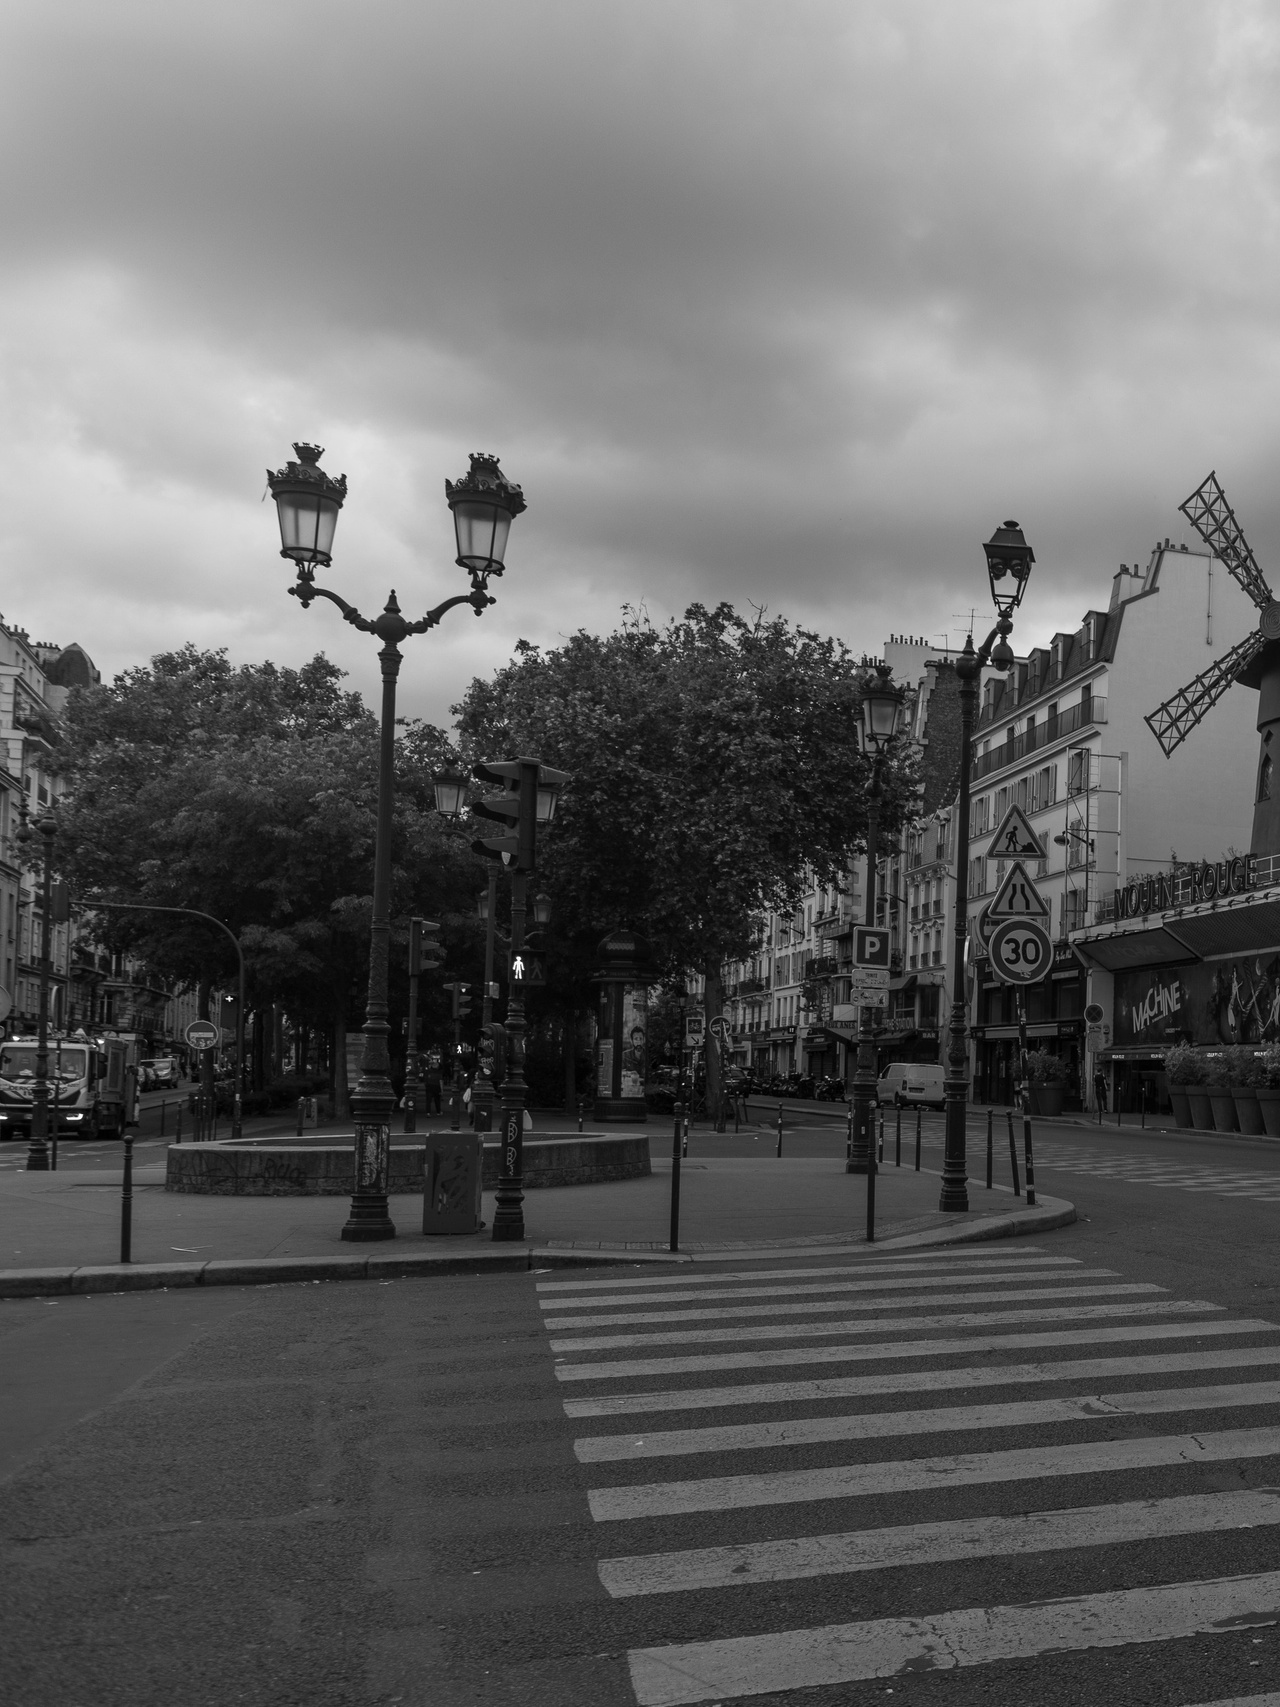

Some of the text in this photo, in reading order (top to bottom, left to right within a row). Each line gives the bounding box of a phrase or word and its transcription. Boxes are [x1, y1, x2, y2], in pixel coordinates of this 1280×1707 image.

[1114, 853, 1258, 920] MOULIN ROUGE
[864, 935, 881, 959] P
[1003, 938, 1041, 965] 30
[1132, 980, 1181, 1034] MACHINE
